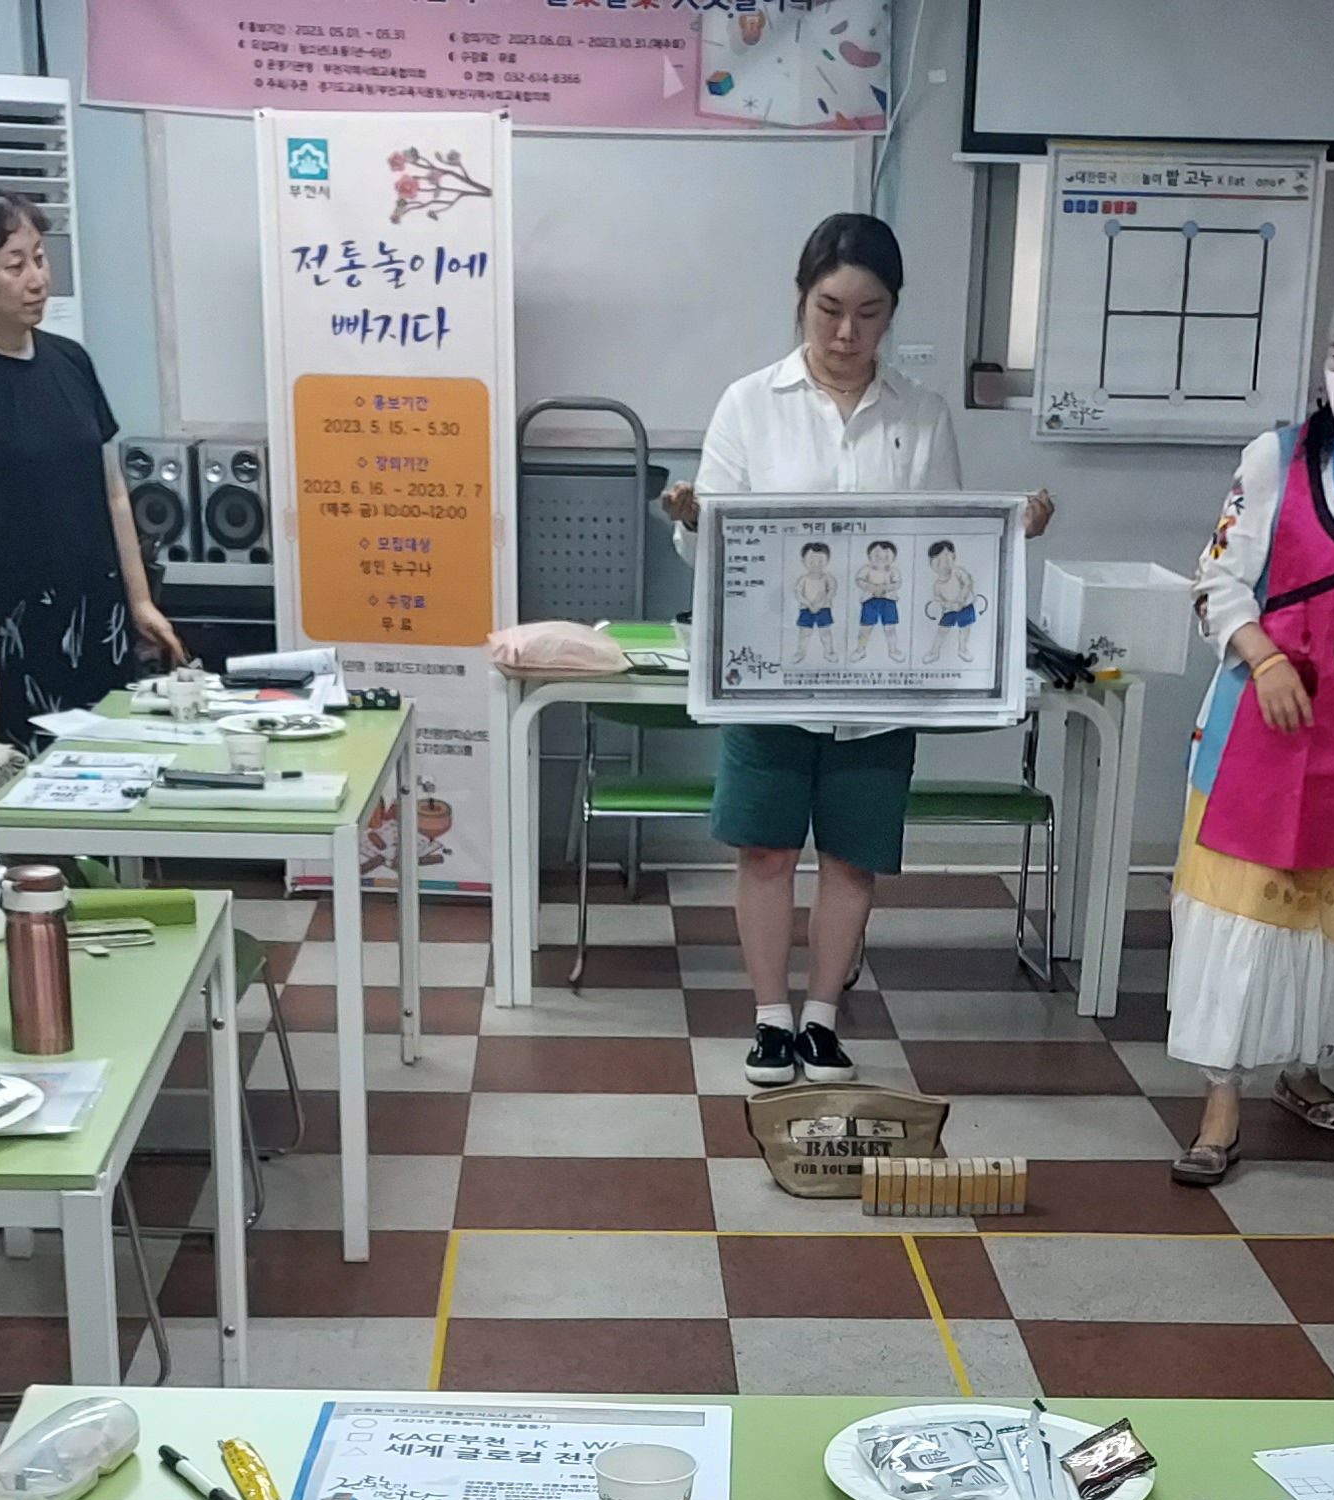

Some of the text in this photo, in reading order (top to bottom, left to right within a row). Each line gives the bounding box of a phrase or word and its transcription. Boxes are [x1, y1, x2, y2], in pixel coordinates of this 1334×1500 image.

[1183, 169, 1215, 188] 고누
[289, 184, 331, 200] 부천시
[290, 239, 489, 290] 전통놀이에
[331, 305, 451, 351] 빠지다
[373, 395, 430, 412] 홍보기간
[323, 418, 365, 434] 2023.
[303, 479, 344, 495] 2023.
[407, 482, 449, 498] 2023.
[377, 537, 431, 554] 모집대상
[359, 560, 432, 577] 성인 누구나
[386, 593, 426, 609] 수강료
[805, 1140, 893, 1157] BASKET
[794, 1163, 847, 1175] FOR YOU
[388, 1432, 505, 1448] KACE부천
[384, 1443, 444, 1458] 세계
[453, 1446, 543, 1464] 글로컬
